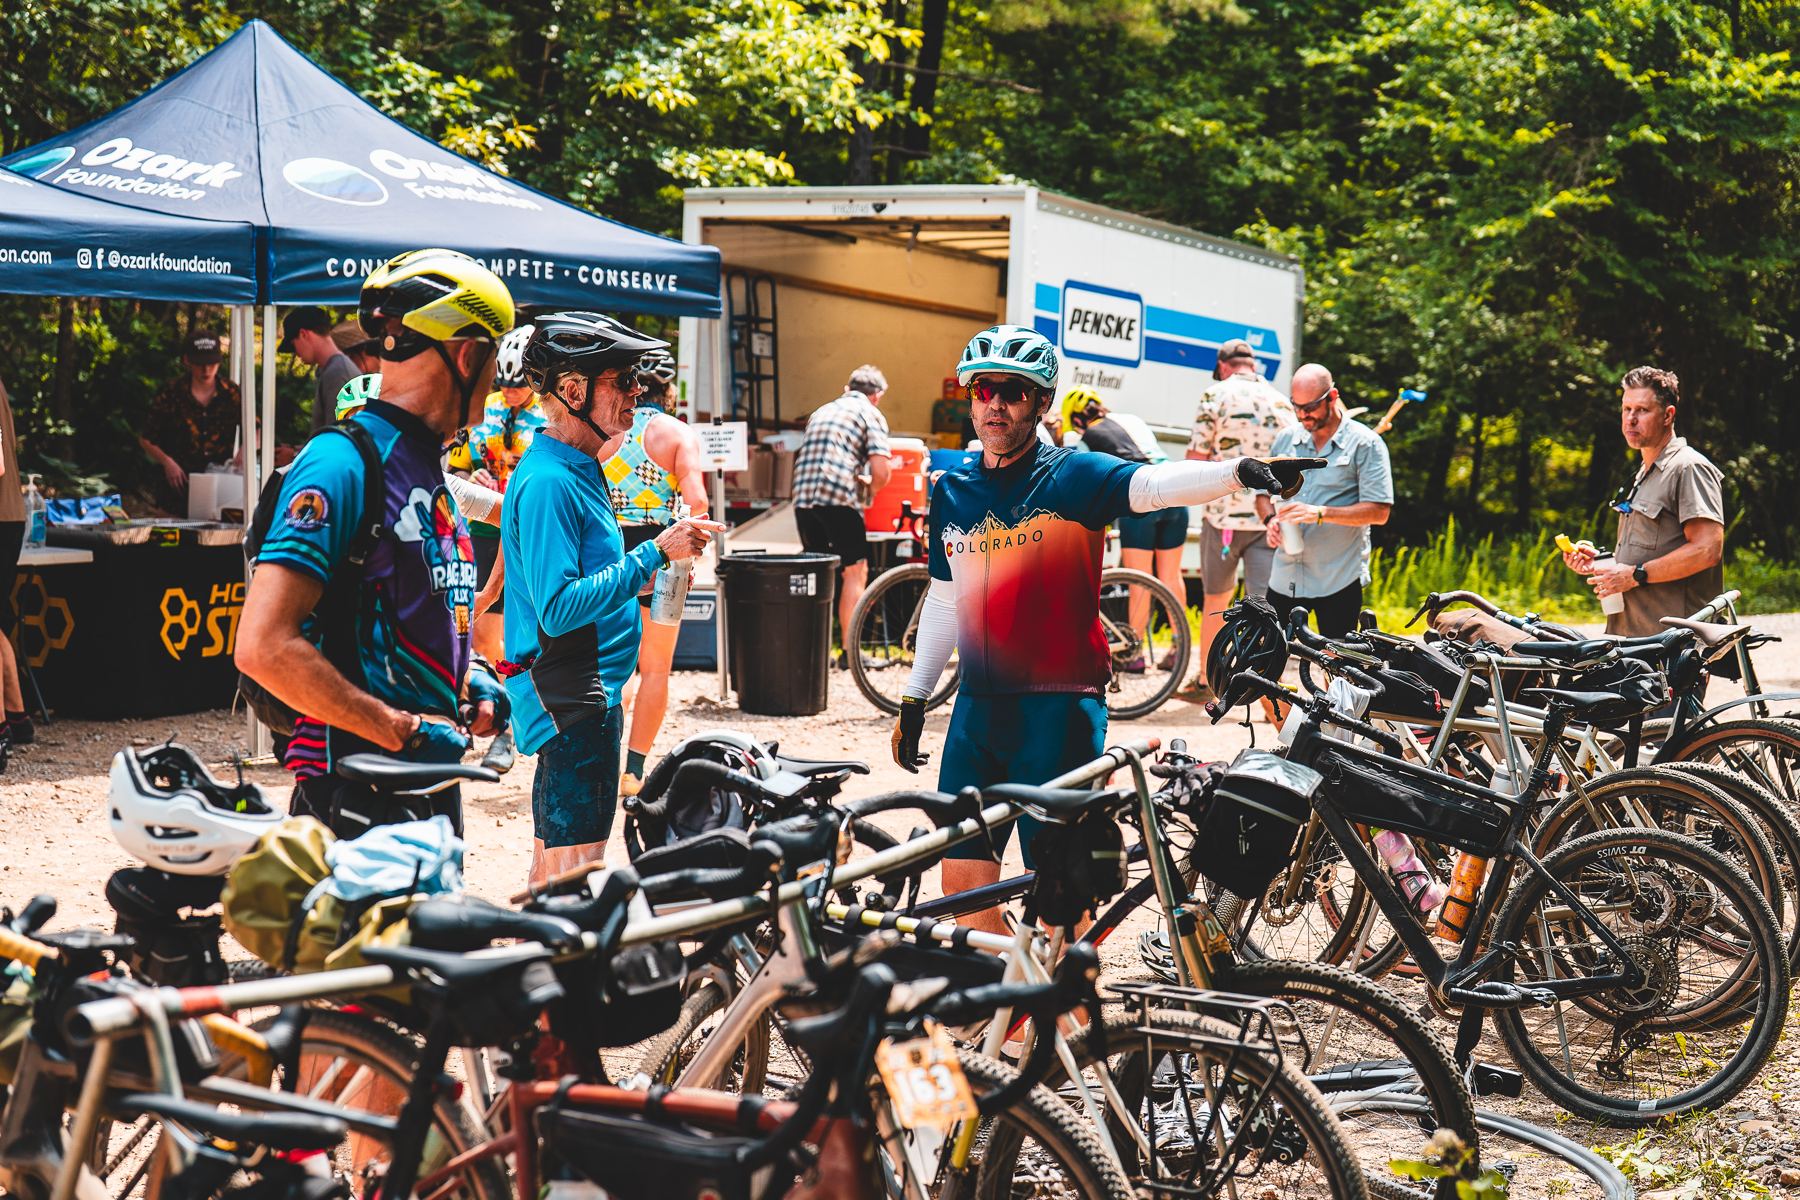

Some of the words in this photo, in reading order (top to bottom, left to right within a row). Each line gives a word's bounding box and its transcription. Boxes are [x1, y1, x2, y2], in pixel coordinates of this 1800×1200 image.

[81, 137, 242, 188] Ozark
[53, 168, 207, 201] Foundation
[108, 250, 232, 275] @ozarkfoundation
[577, 265, 679, 293] CONSERVE
[1069, 308, 1137, 341] PENSKE
[946, 530, 1043, 558] COLORADO
[1597, 846, 1627, 859] SWISS
[1629, 845, 1647, 855] DT
[1284, 981, 1336, 995] ARDENT
[892, 1063, 957, 1114] 163
